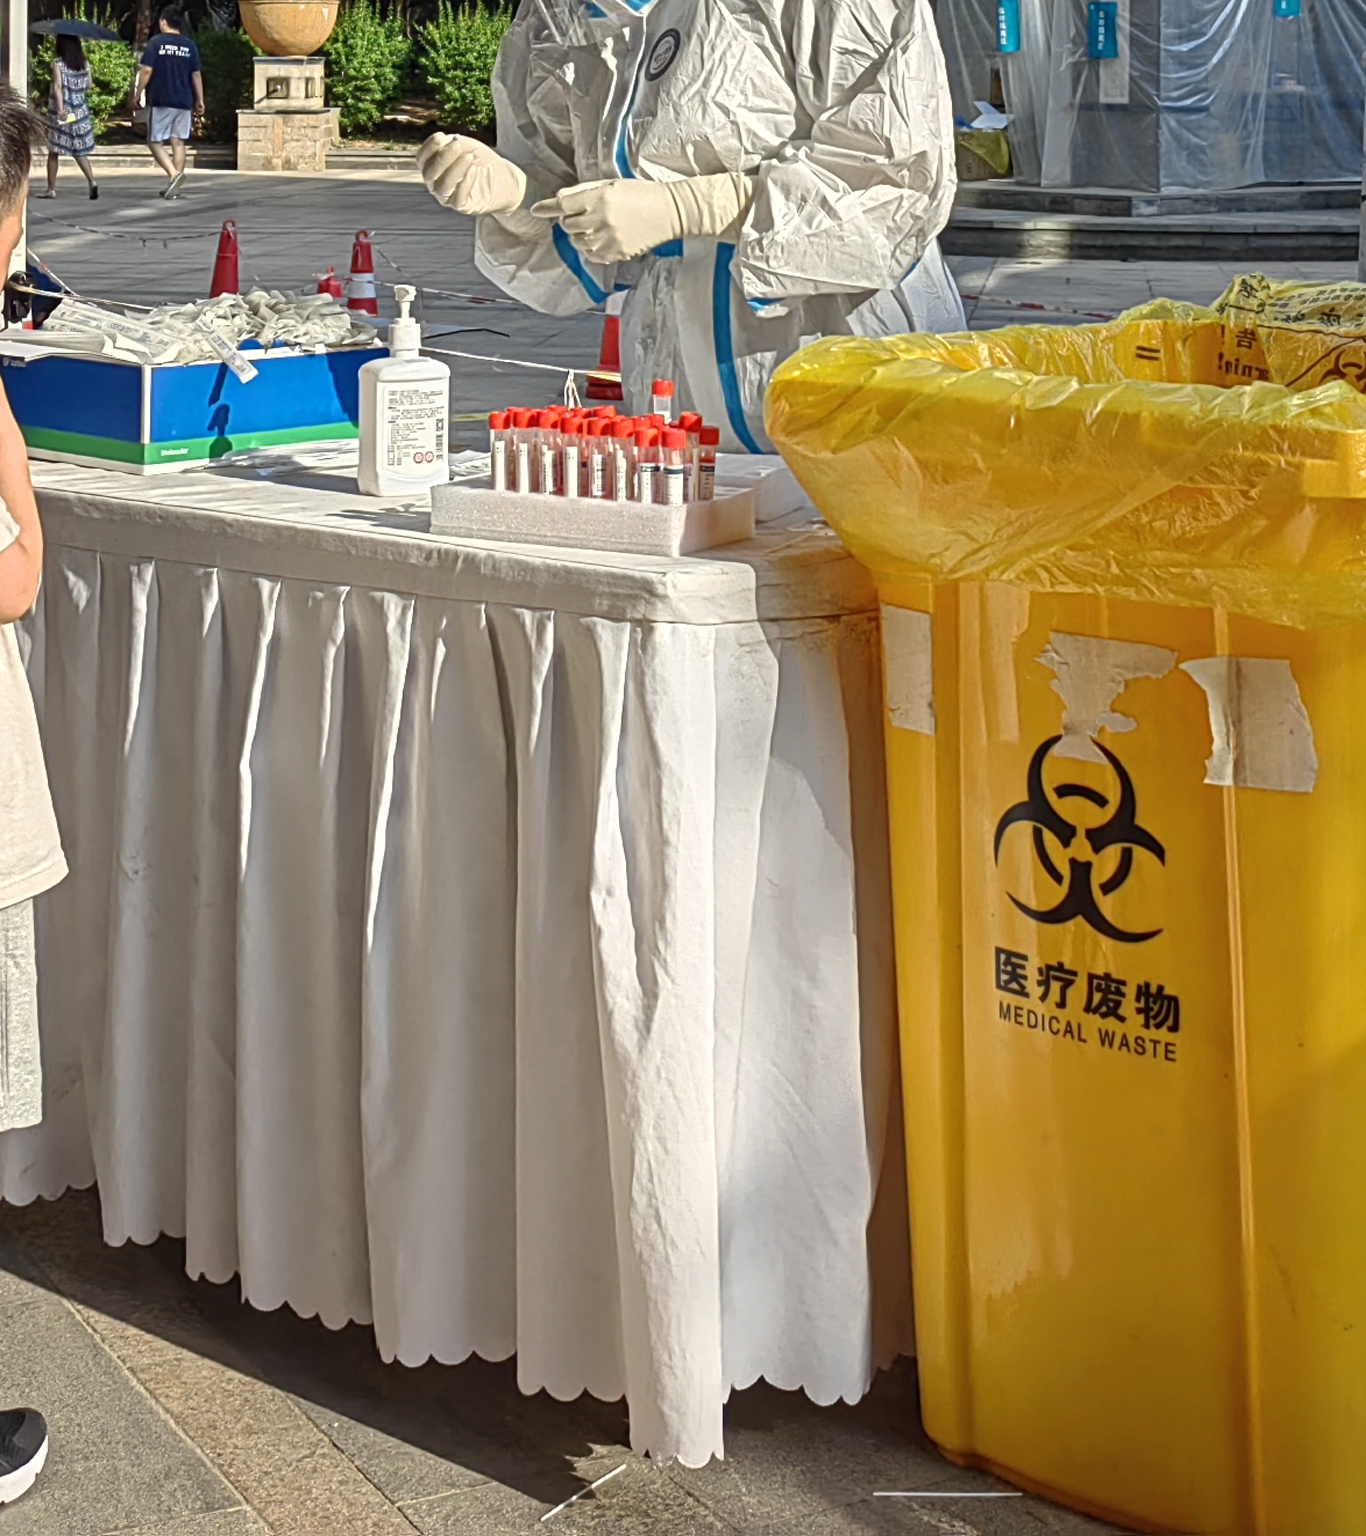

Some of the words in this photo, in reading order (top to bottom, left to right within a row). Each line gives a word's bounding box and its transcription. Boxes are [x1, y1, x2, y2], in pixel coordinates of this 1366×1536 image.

[995, 946, 1180, 1033] 医疗废物
[999, 1000, 1087, 1043] MEDICAL
[1098, 1027, 1177, 1062] WASTE
